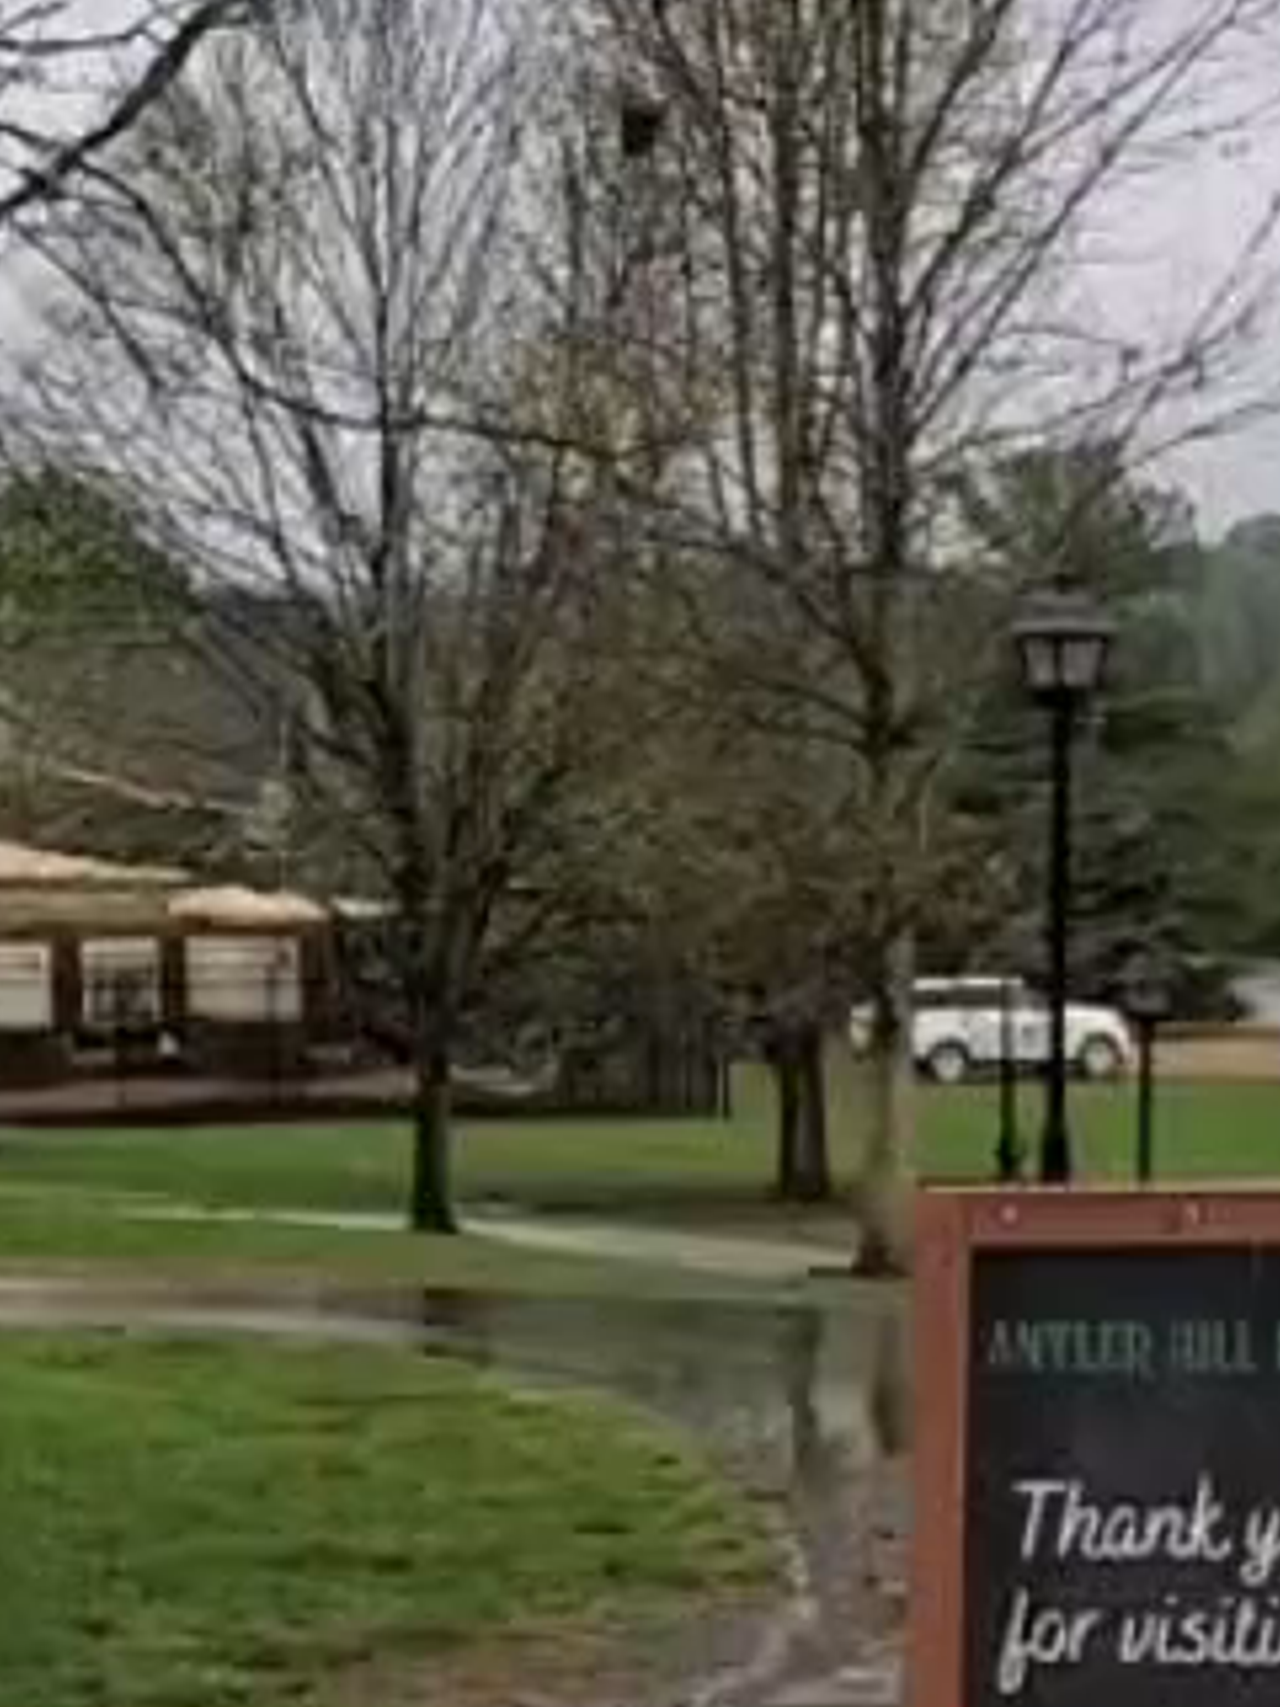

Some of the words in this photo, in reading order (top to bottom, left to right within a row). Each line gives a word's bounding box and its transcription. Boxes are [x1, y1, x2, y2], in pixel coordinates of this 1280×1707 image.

[988, 1319, 1153, 1374] ANTLER
[1170, 1318, 1257, 1373] HILL
[1013, 1473, 1233, 1561] Thank
[998, 1589, 1101, 1695] for
